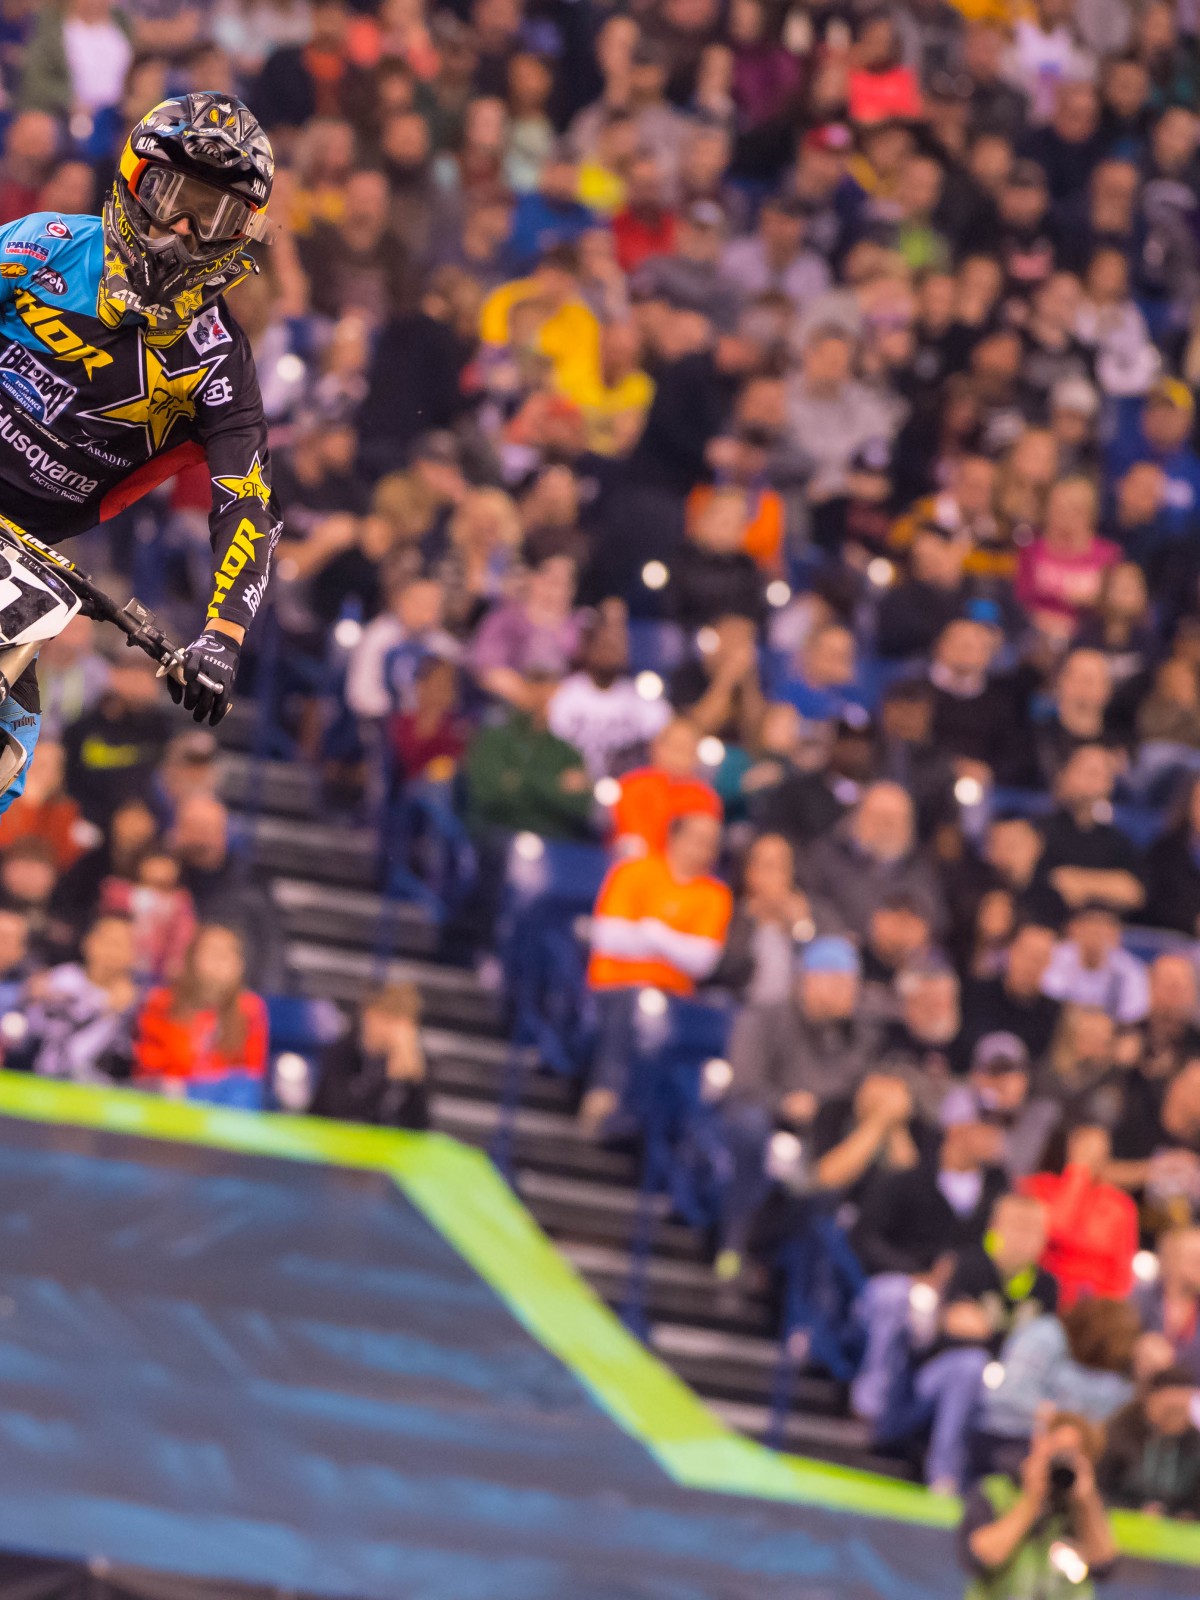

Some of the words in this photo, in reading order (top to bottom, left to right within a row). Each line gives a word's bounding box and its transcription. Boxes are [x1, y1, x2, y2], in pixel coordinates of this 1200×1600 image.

[6, 241, 49, 257] PARTS
[111, 289, 172, 320] ATLAS
[2, 381, 34, 413] LUBRICANTS
[29, 472, 61, 494] FACTORY
